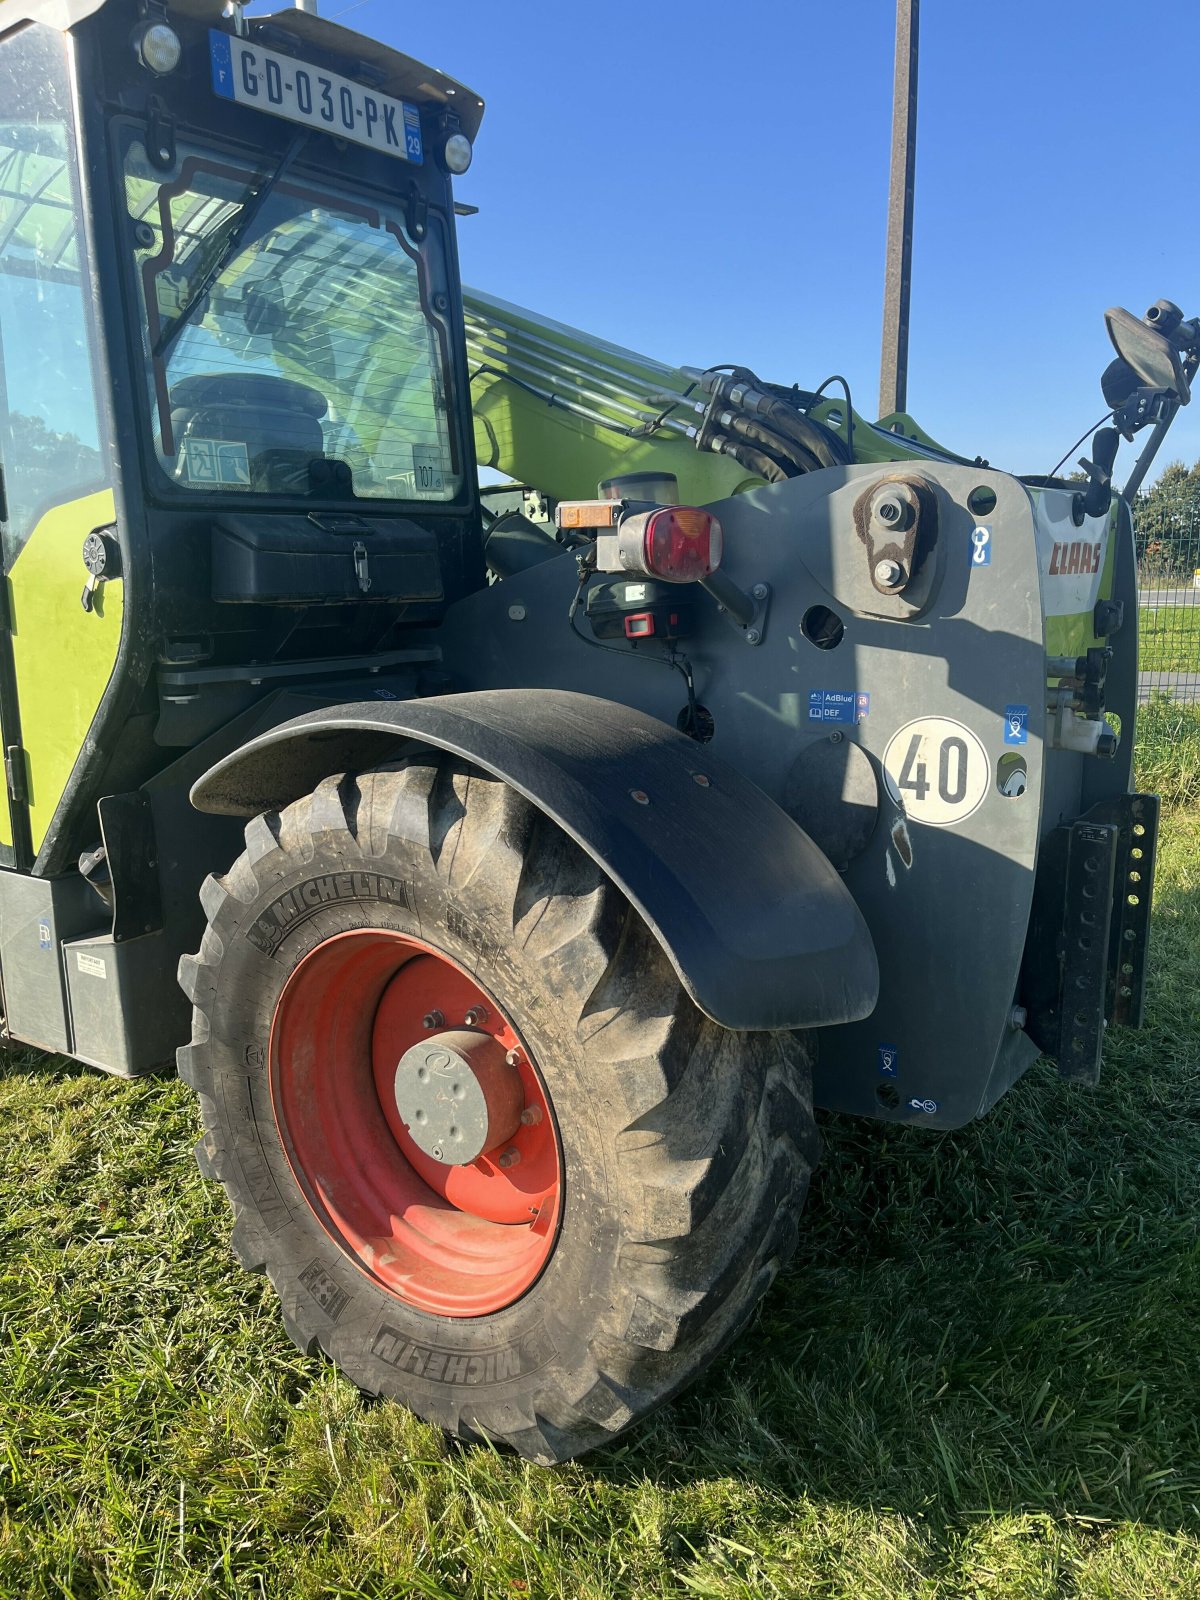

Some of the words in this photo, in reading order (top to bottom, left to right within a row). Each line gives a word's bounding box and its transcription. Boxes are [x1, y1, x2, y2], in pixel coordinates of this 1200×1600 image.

[218, 69, 226, 84] F
[240, 50, 399, 147] GD-030-PK
[407, 135, 420, 156] 29
[1048, 541, 1102, 576] CLAAS
[824, 708, 840, 717] DEF
[825, 694, 853, 703] AdBlue
[897, 733, 969, 805] 40
[273, 873, 405, 927] MICHELIN
[375, 1332, 521, 1384] MICHELIN
